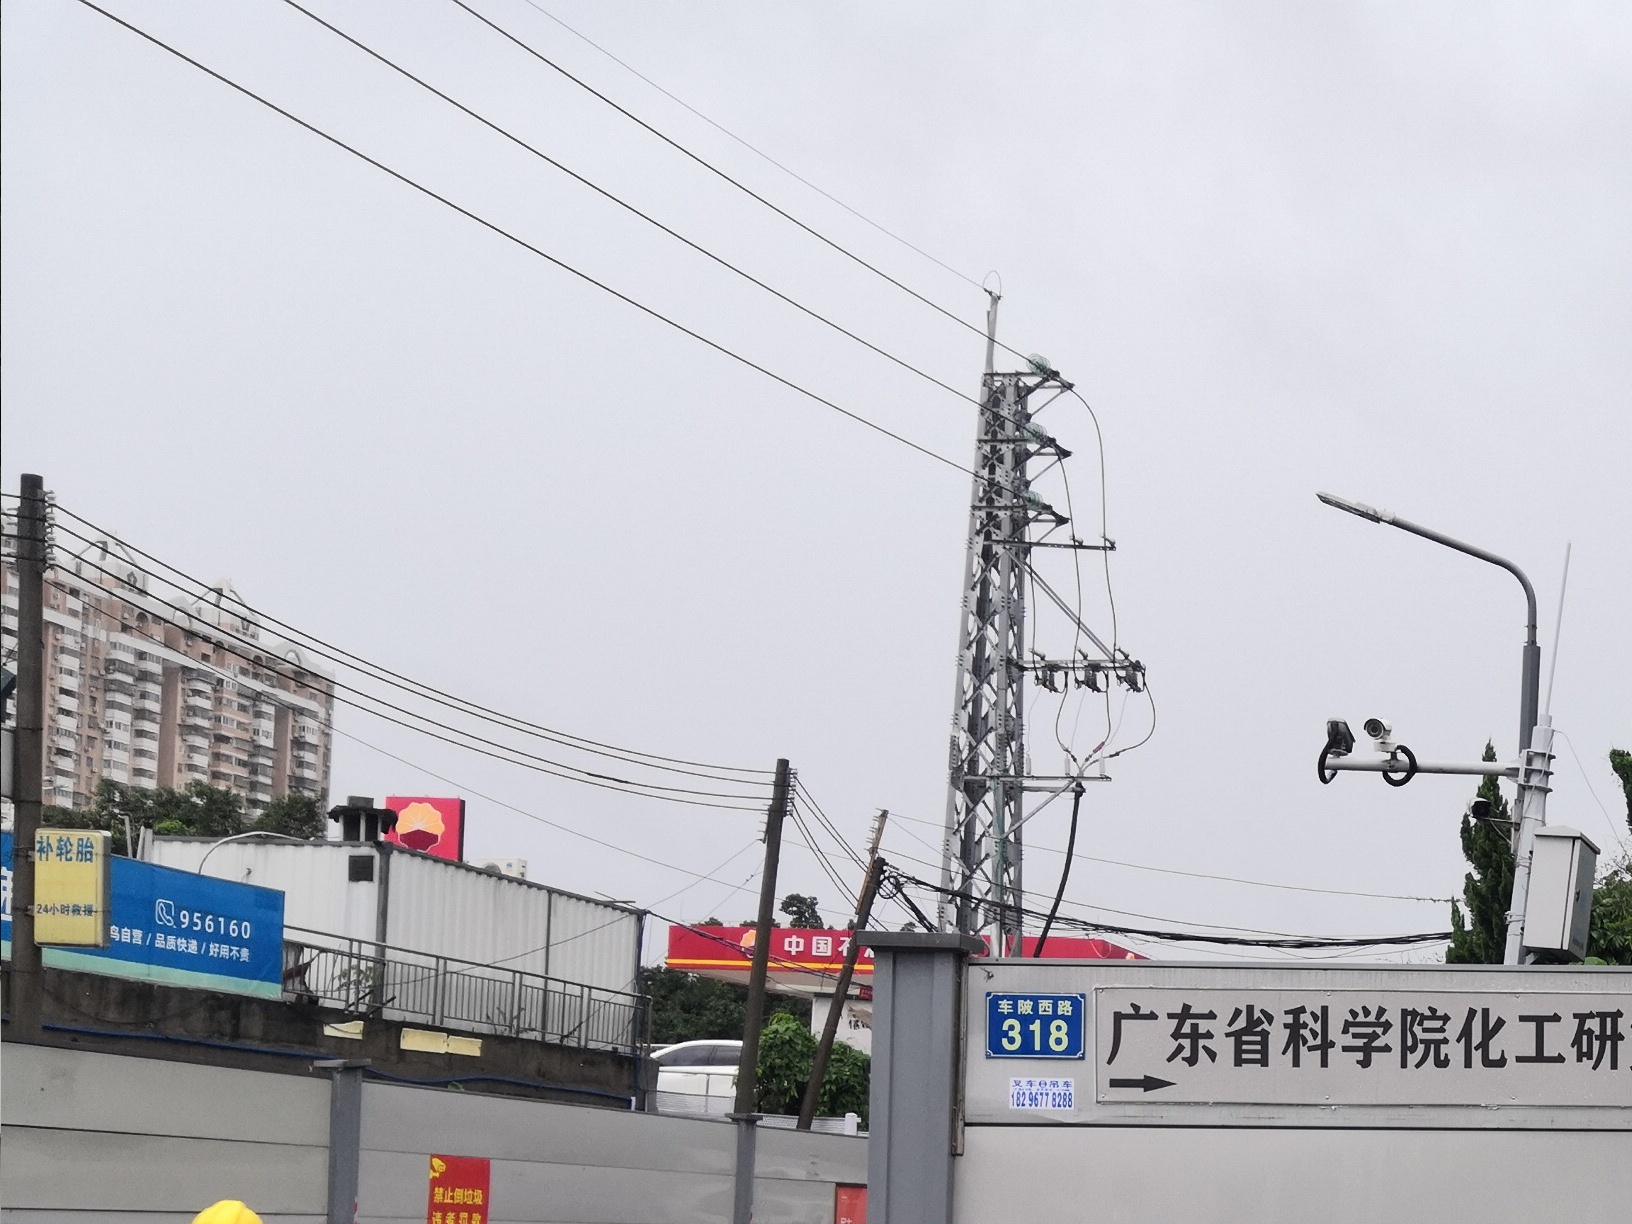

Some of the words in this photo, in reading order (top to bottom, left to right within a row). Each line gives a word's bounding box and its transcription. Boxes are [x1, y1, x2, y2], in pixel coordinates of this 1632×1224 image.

[37, 835, 95, 864] 补轮胎
[179, 910, 251, 940] 956160
[997, 999, 1073, 1016] 车陂西路
[1001, 1018, 1069, 1052] 318
